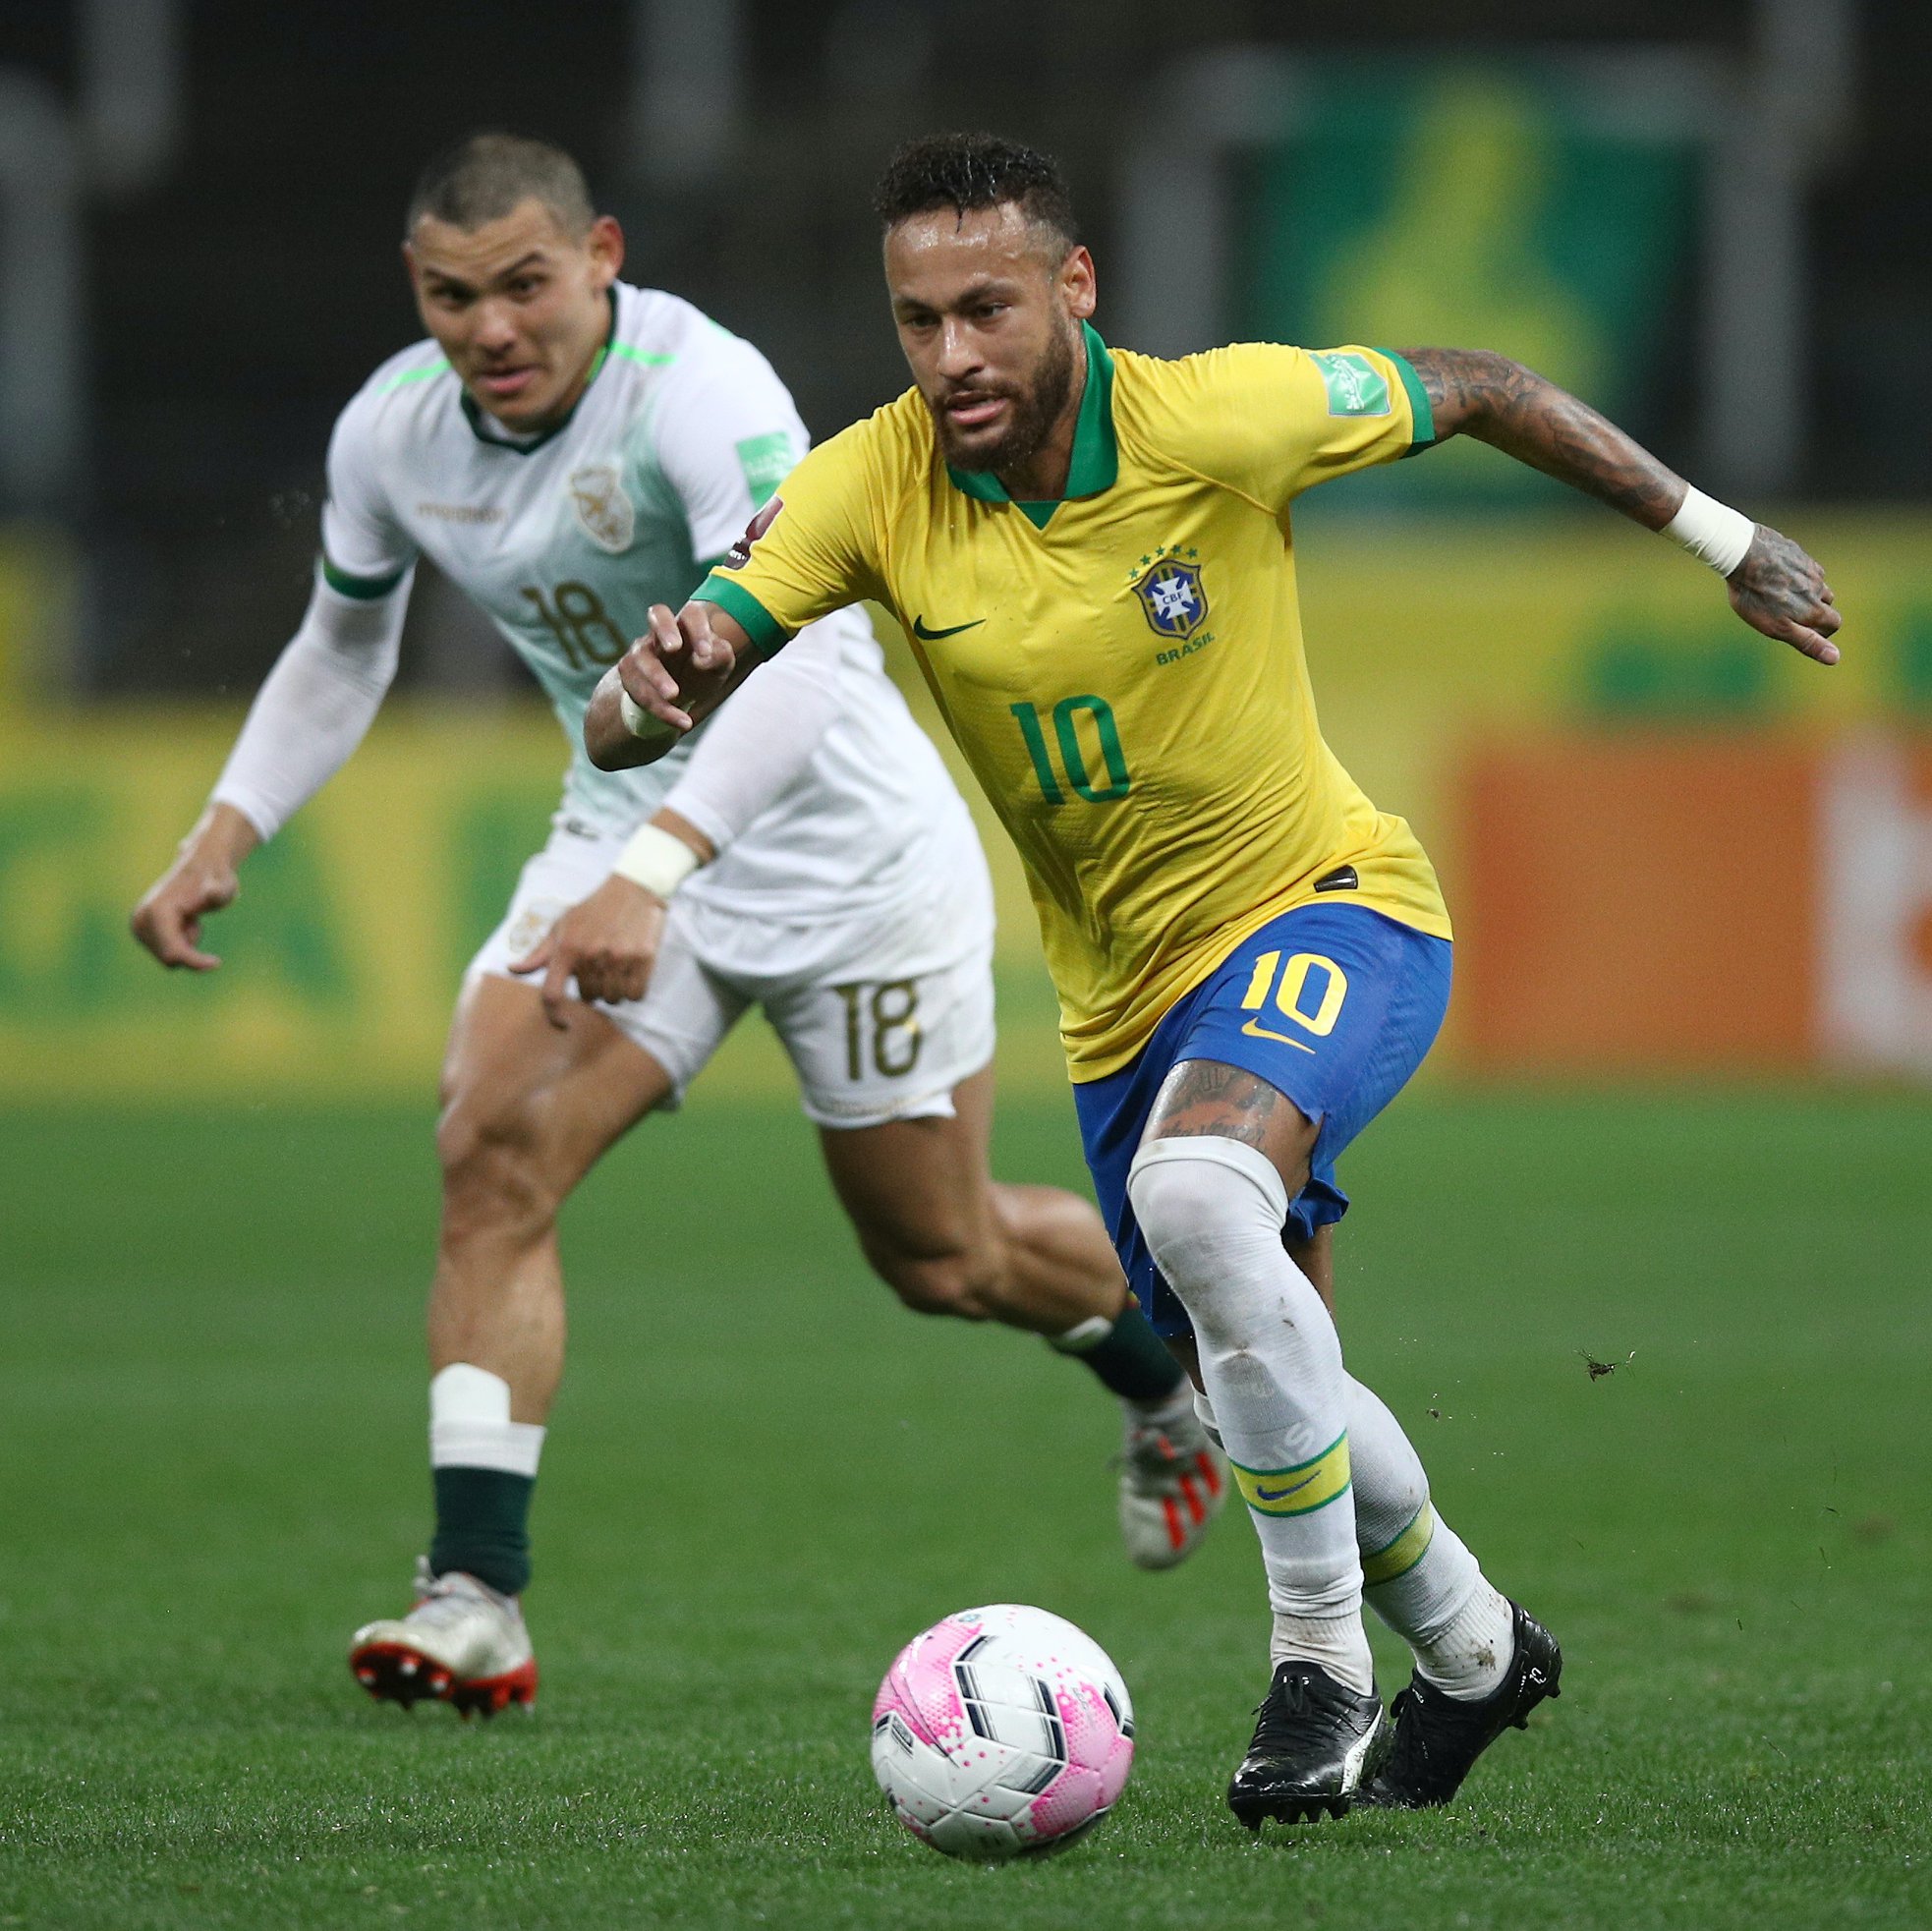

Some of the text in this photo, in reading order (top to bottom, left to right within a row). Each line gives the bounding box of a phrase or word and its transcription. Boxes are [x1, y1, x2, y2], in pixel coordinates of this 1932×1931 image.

[520, 580, 628, 671] 18
[1163, 591, 1184, 605] CBF
[1156, 632, 1216, 665] BRASIL
[1009, 694, 1130, 806] 10
[831, 980, 922, 1082] 18
[1240, 950, 1348, 1037] 10
